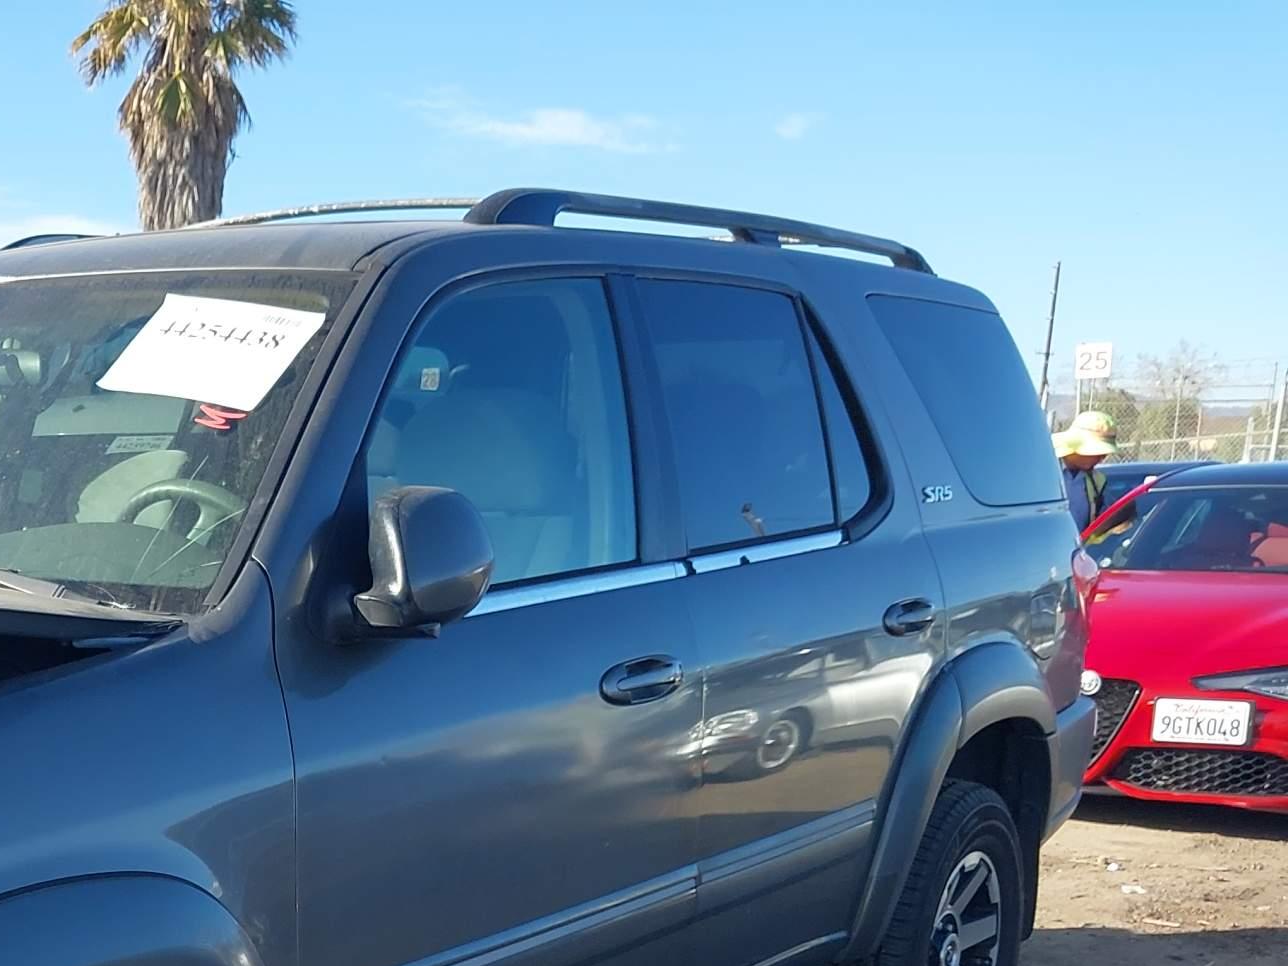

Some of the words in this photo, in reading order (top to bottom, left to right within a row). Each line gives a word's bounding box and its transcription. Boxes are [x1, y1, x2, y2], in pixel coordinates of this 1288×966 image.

[159, 320, 286, 350] 44254438
[1079, 351, 1108, 371] 25
[922, 485, 953, 503] SR5
[1159, 715, 1242, 738] 9GTK048
